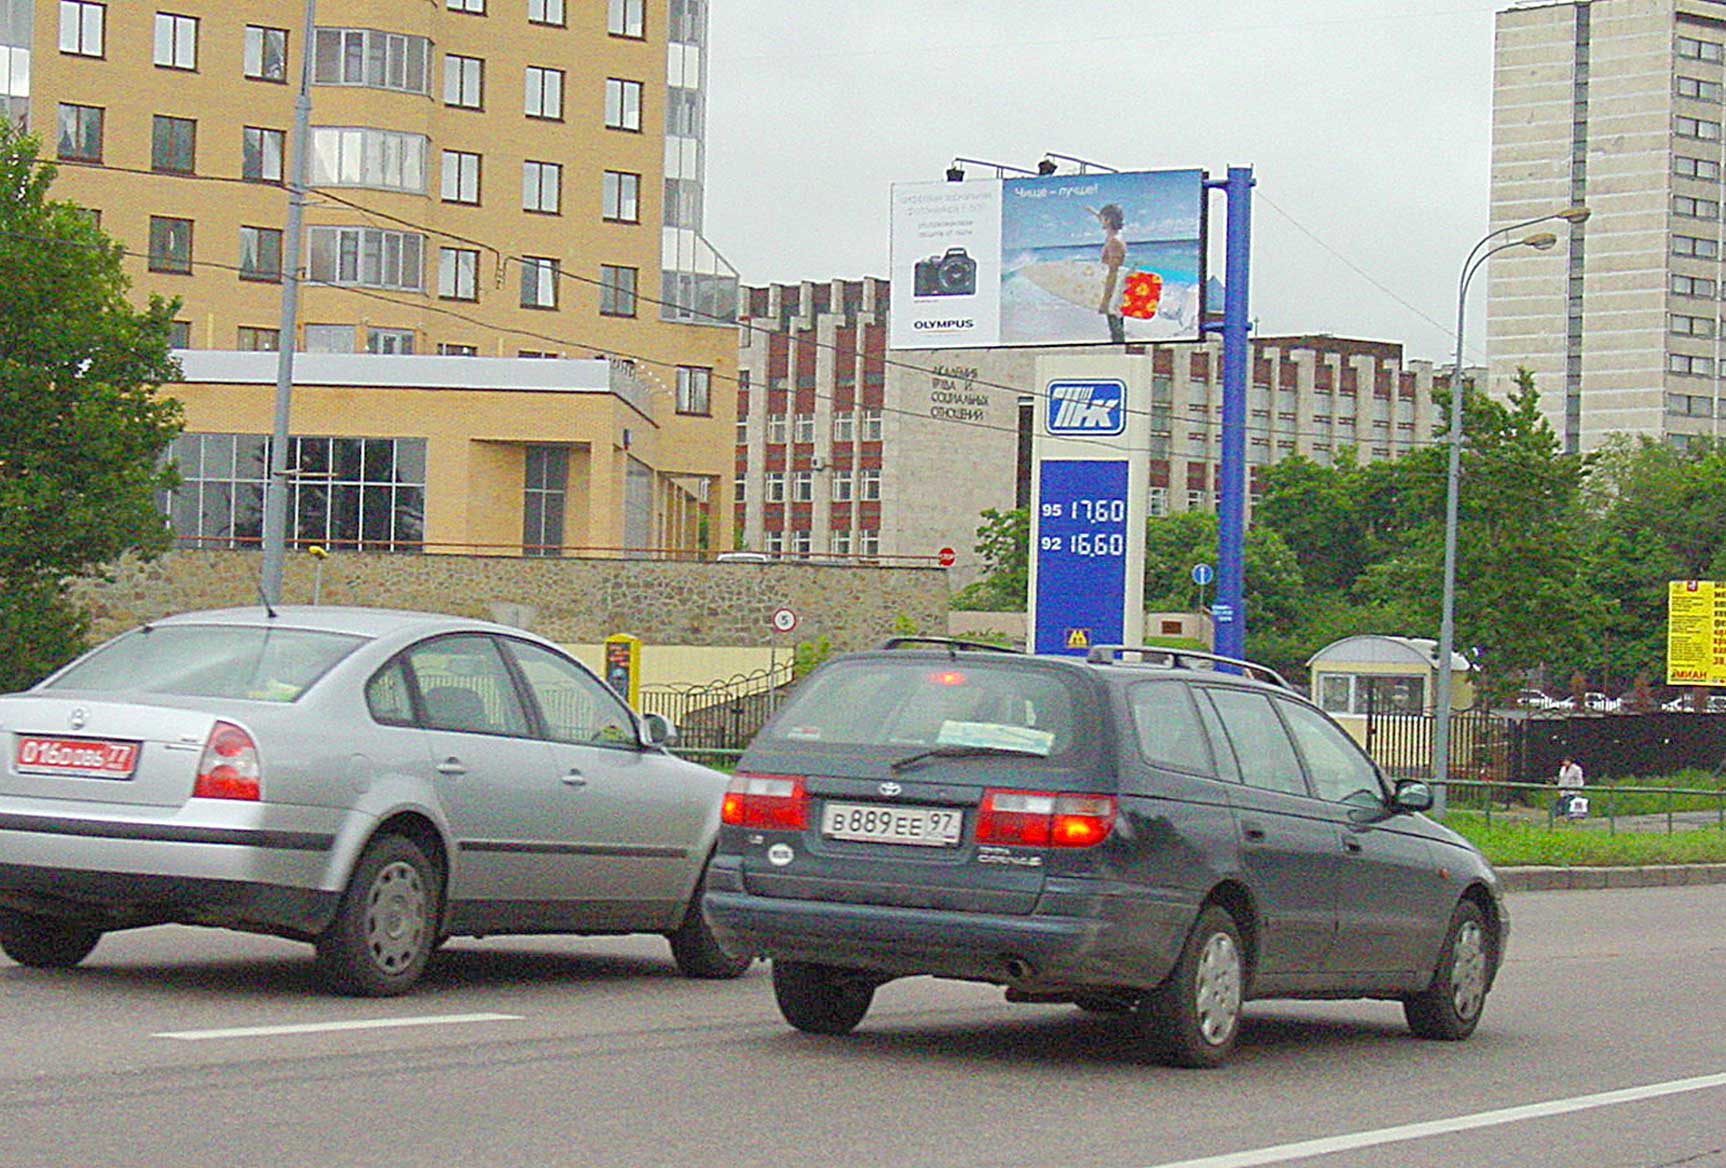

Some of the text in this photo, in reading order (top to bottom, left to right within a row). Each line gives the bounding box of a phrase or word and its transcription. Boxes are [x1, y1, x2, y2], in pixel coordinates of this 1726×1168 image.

[914, 319, 975, 330] OLYMPUS
[1041, 503, 1062, 517] 95
[1041, 536, 1062, 550] 92
[780, 614, 788, 626] 5
[929, 812, 953, 831] 97
